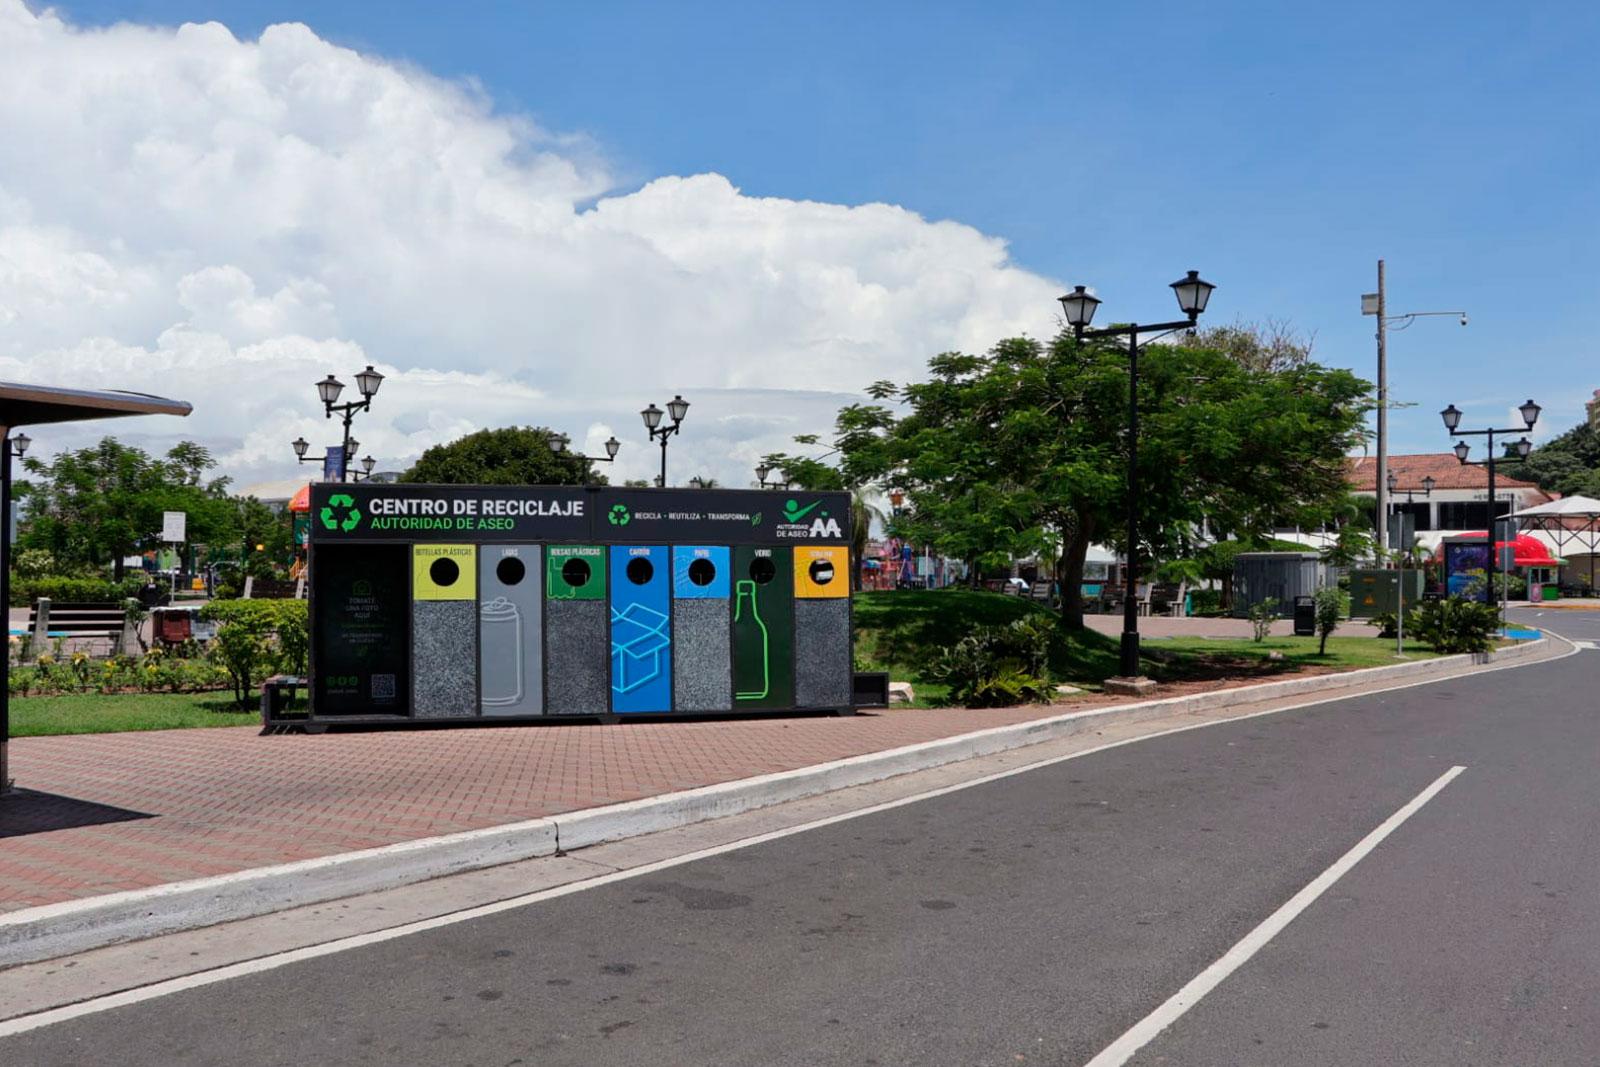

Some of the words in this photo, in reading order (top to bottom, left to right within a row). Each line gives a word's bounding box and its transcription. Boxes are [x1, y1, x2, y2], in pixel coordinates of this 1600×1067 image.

[369, 498, 448, 515] CENTRO
[453, 499, 478, 515] DE
[482, 499, 584, 516] RECICLAJE
[634, 512, 662, 520] RECICLA
[668, 512, 701, 521] REUTILIZA
[707, 512, 750, 521] TRANSFORMA
[370, 517, 453, 529] AUTORIDAD
[456, 517, 475, 530] DE
[477, 518, 515, 530] ASEO
[776, 530, 787, 538] DE
[788, 530, 809, 538] ASEO
